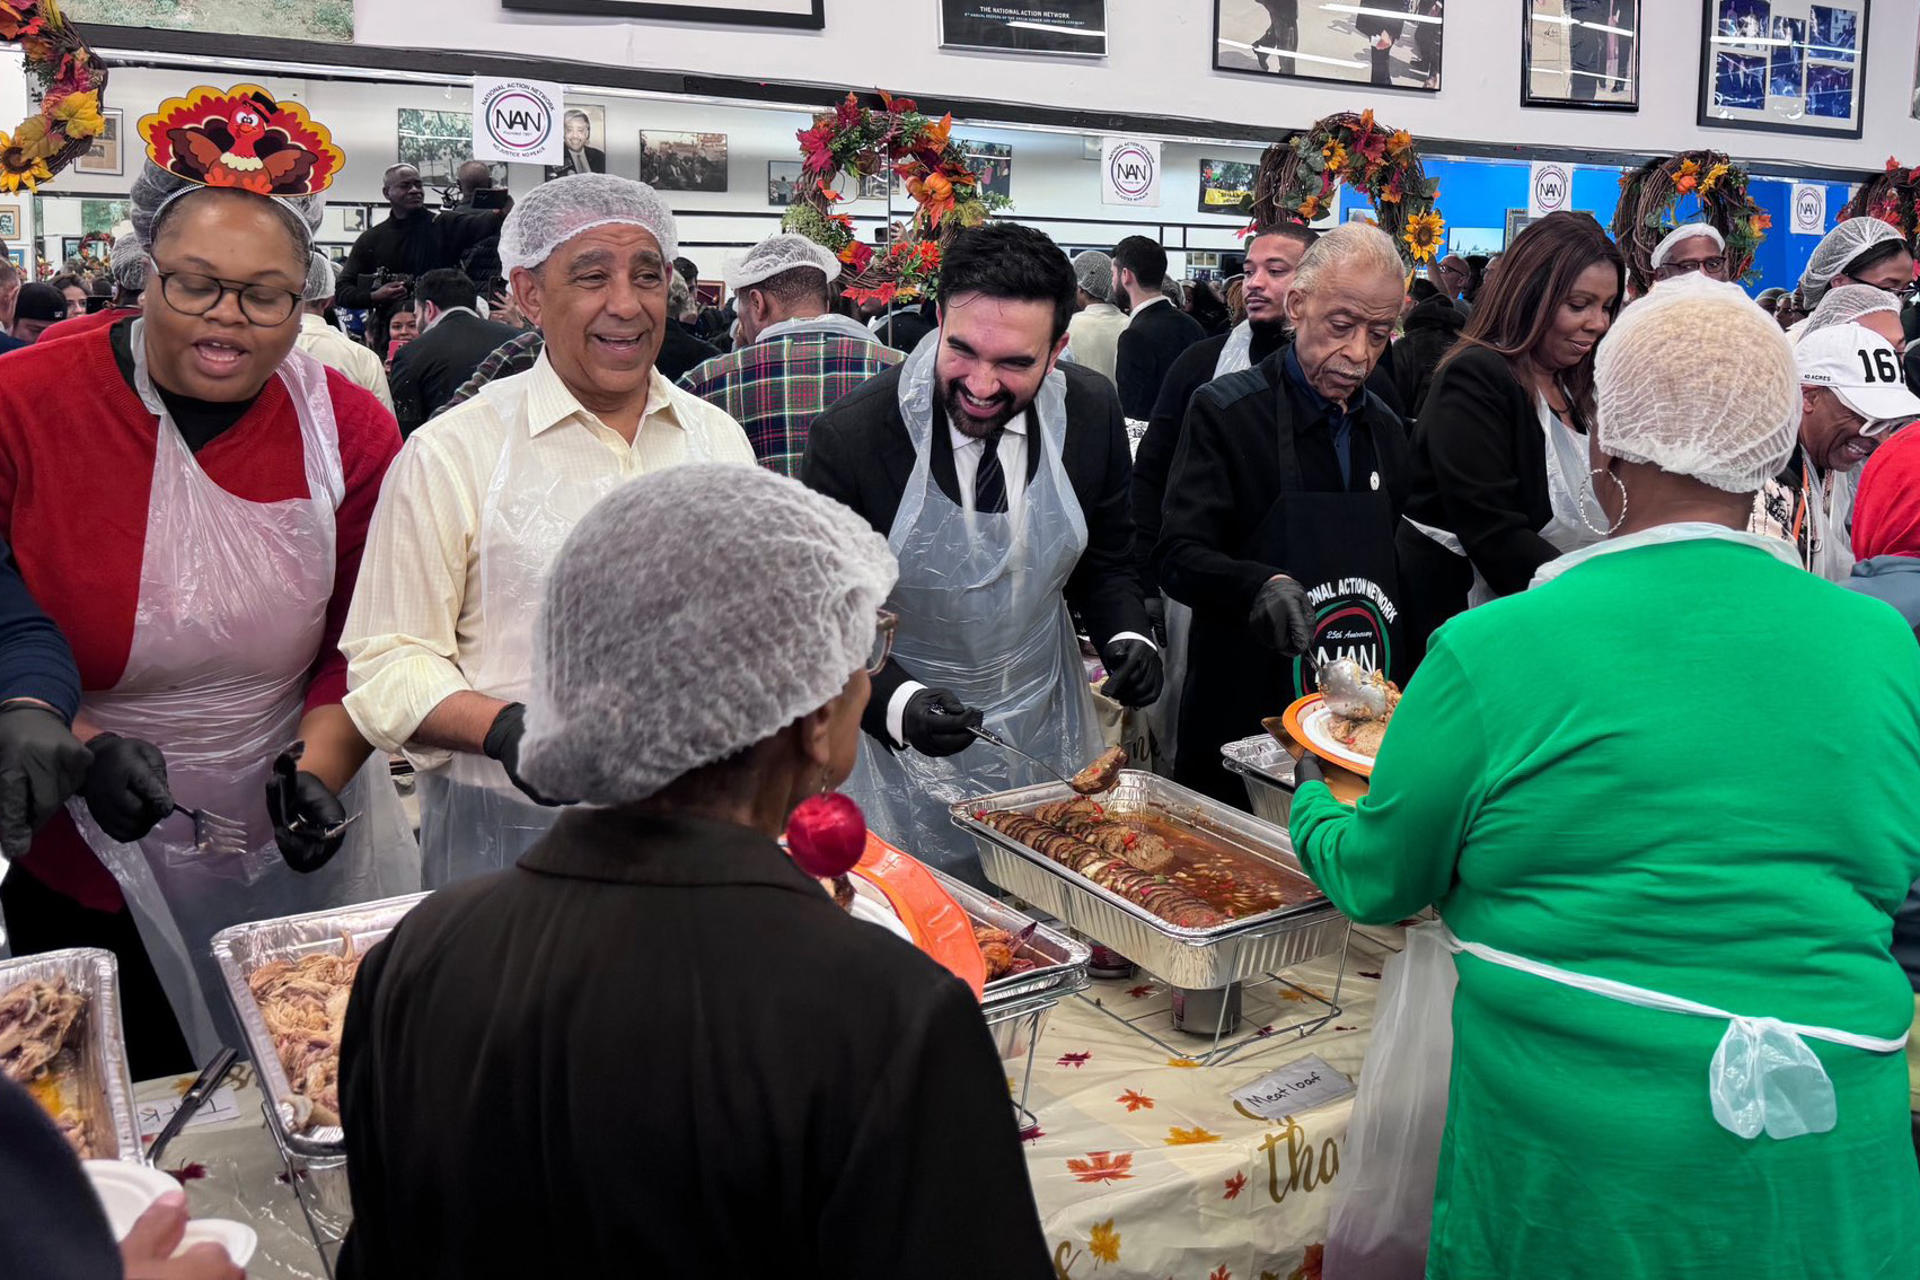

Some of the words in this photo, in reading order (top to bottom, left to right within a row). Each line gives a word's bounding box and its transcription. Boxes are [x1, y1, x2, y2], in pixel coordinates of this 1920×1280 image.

[992, 7, 1020, 16] NATIONAL
[1021, 9, 1042, 17] ACTION
[1043, 11, 1070, 19] NETWORK
[482, 85, 505, 106] NATIONAL
[507, 82, 530, 90] ACTION
[531, 87, 555, 111] NETWORK
[496, 109, 541, 132] NAN
[500, 148, 520, 157] JUSTICE
[1117, 163, 1146, 181] NAN
[1540, 183, 1562, 198] NAN
[1800, 203, 1818, 215] NAN
[1307, 582, 1337, 606] ONAL
[1338, 577, 1367, 596] ACTION
[1366, 580, 1398, 624] NETWORK
[1326, 630, 1343, 640] 25th
